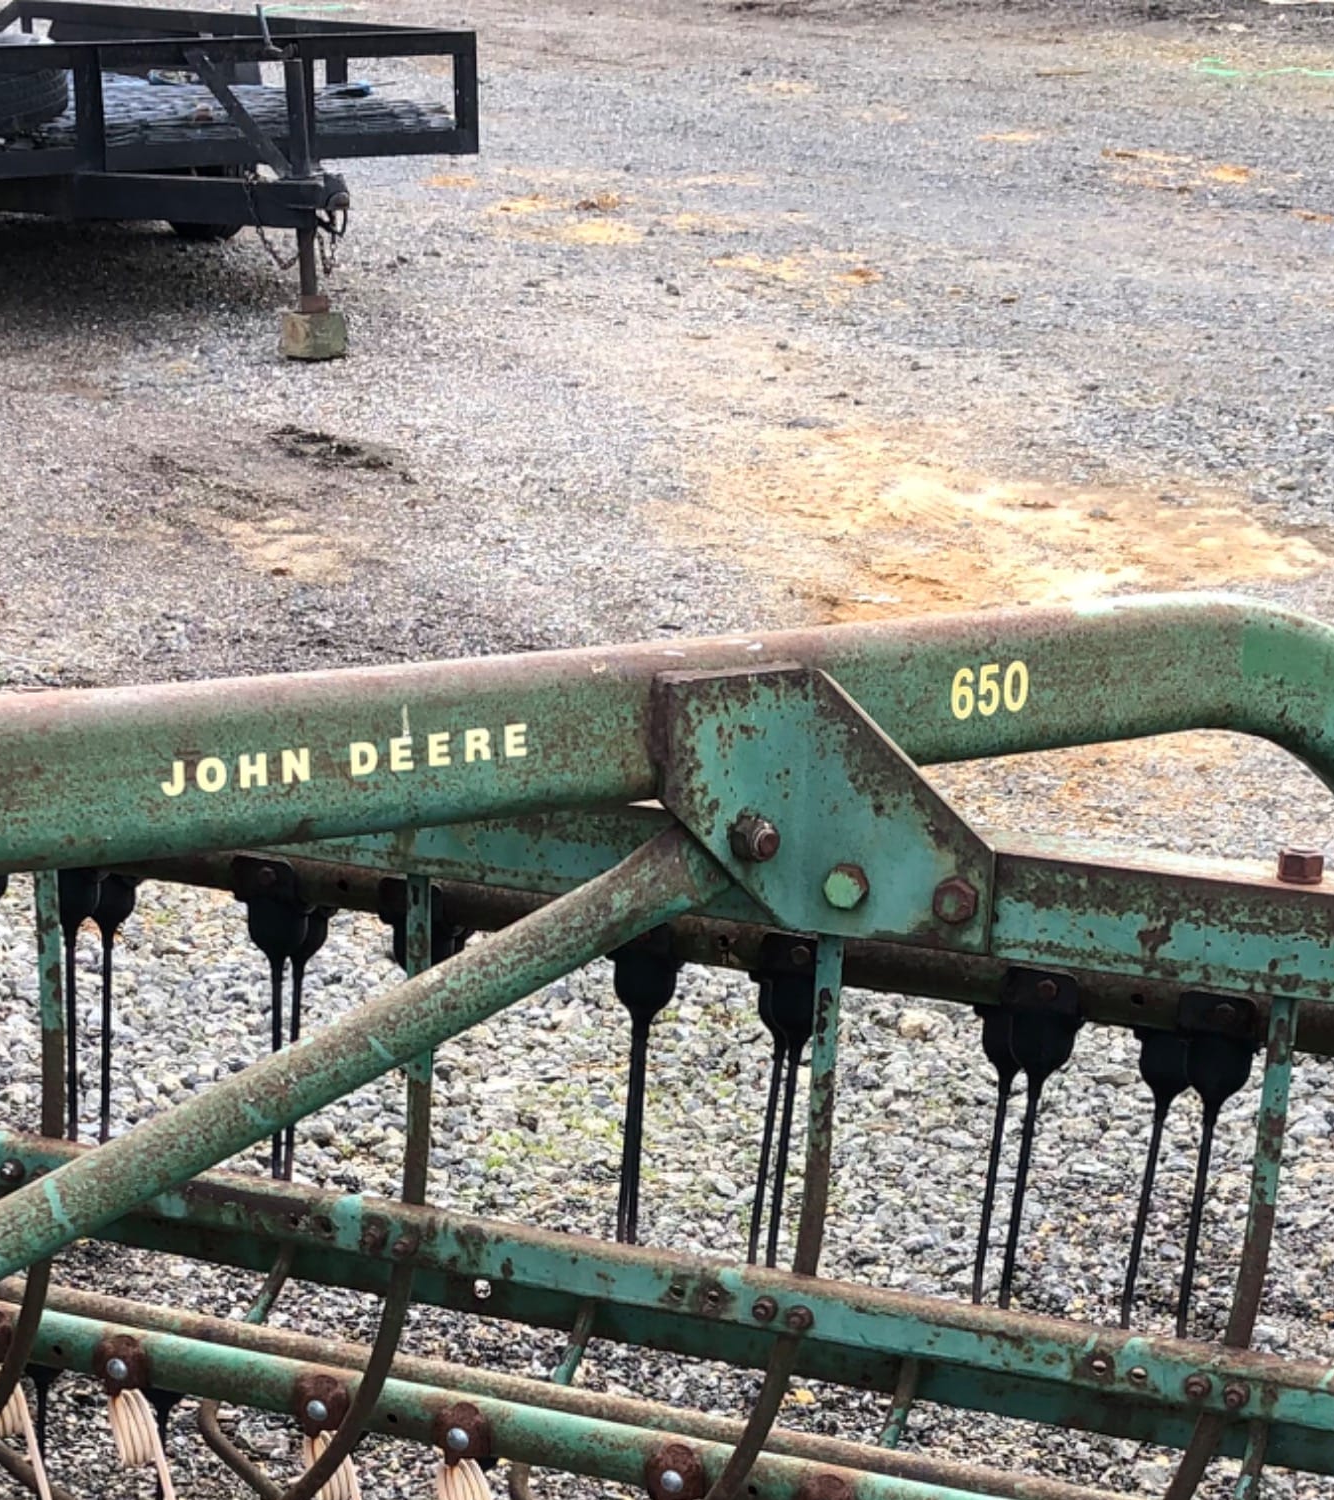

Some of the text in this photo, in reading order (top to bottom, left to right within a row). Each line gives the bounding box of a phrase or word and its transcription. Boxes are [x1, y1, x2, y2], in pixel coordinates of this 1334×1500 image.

[951, 660, 1030, 720] 650
[161, 723, 528, 796] JOHN DEERE
